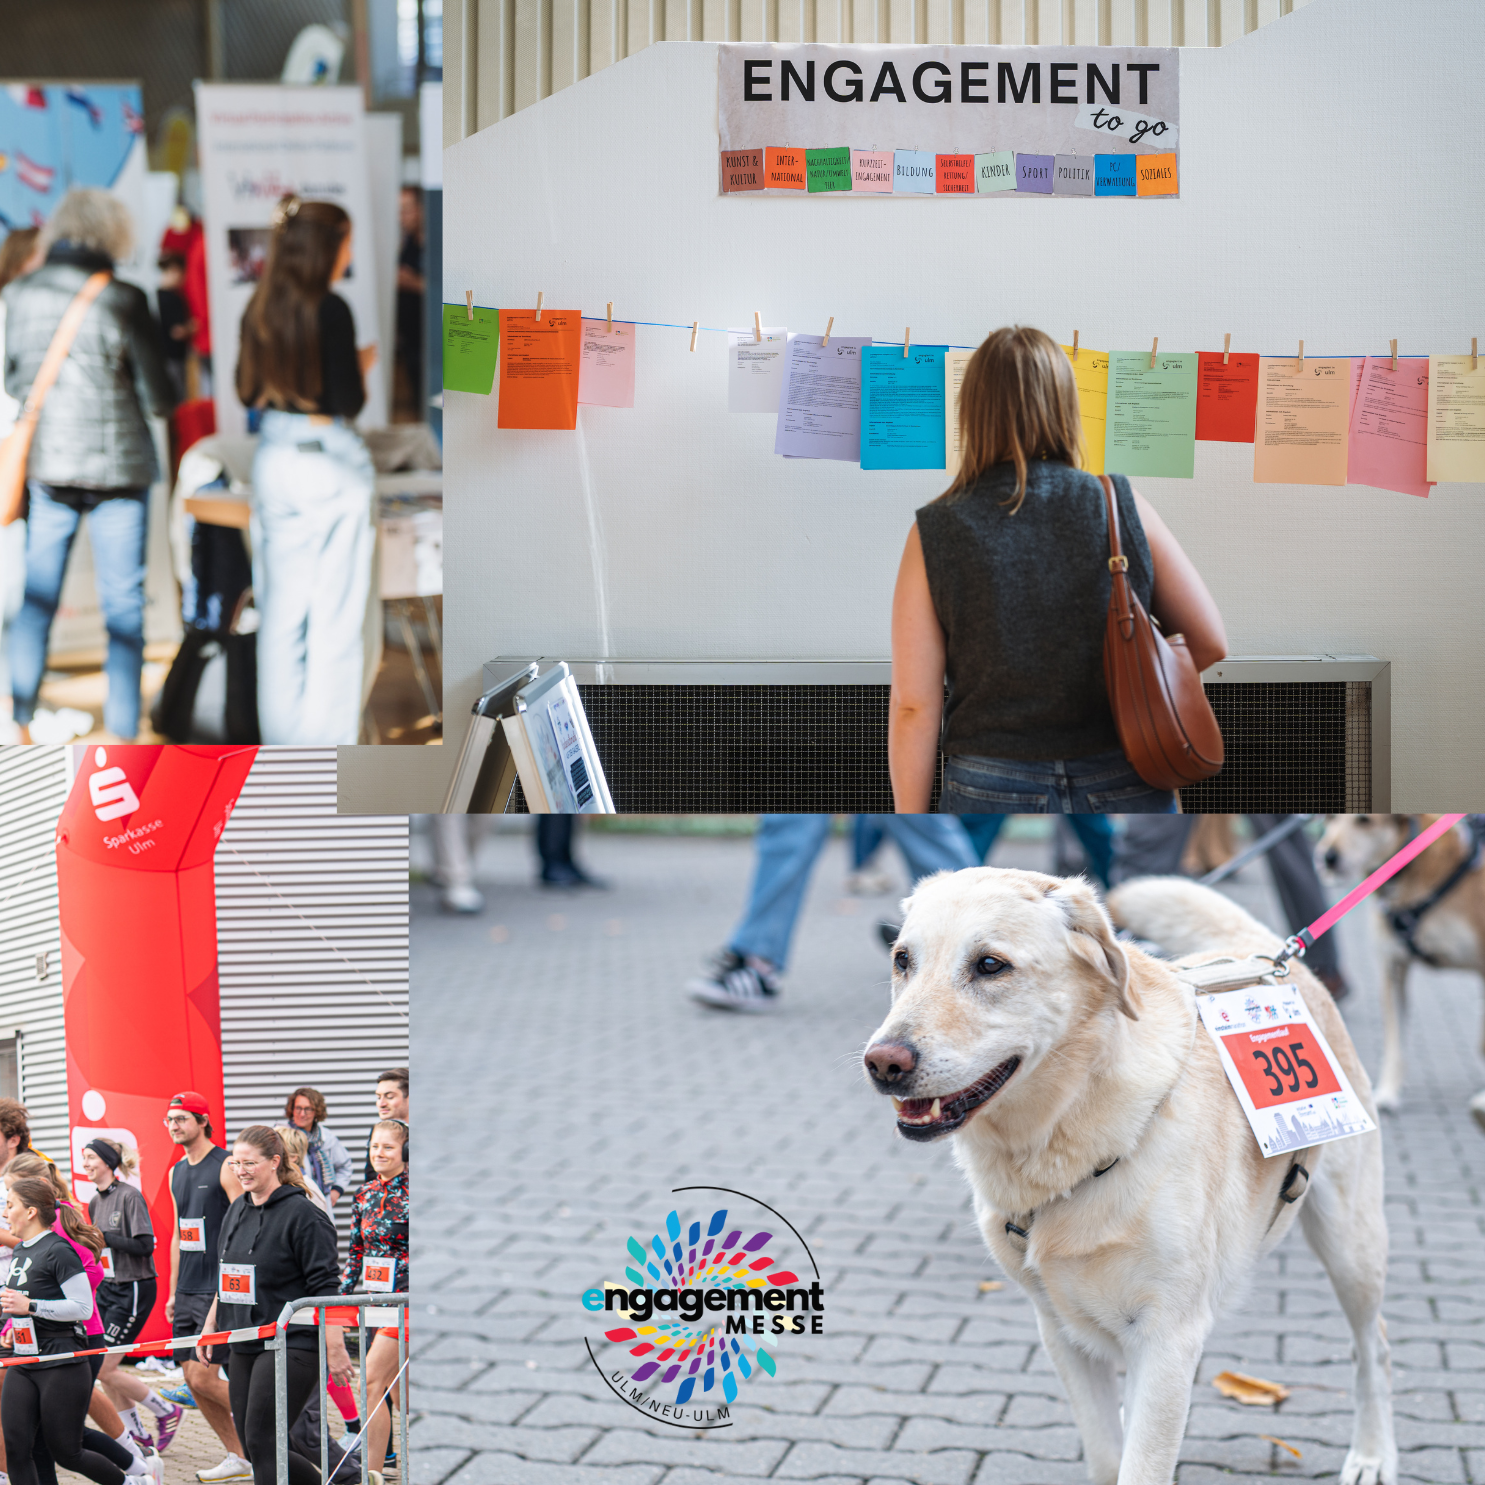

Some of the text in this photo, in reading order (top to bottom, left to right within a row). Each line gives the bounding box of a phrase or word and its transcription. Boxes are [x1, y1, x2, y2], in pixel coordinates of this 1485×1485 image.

[743, 59, 1160, 104] ENGAGEMENT
[1090, 108, 1169, 144] to go
[726, 155, 759, 168] KUNST &
[776, 155, 799, 166] INTER-
[859, 158, 887, 168] KURZZEIT-
[771, 172, 803, 183] NATIONAL
[855, 171, 890, 182] ENGAGEMENT
[896, 164, 934, 178] BILDUNG
[981, 164, 1011, 178] KINDER
[1022, 165, 1049, 179] SPORT
[1058, 166, 1090, 181] POLITIK
[1140, 166, 1172, 180] SOZIALES
[729, 172, 757, 186] KULTUR
[824, 181, 836, 190] TIER
[1096, 176, 1135, 187] VERWALTUNG
[943, 183, 969, 193] SICHERHEIT
[103, 817, 164, 849] Sparkasse
[128, 838, 156, 855] Ulm
[1248, 1026, 1290, 1043] Engagementlauf
[1252, 1042, 1319, 1096] 395
[228, 1279, 241, 1291] 63
